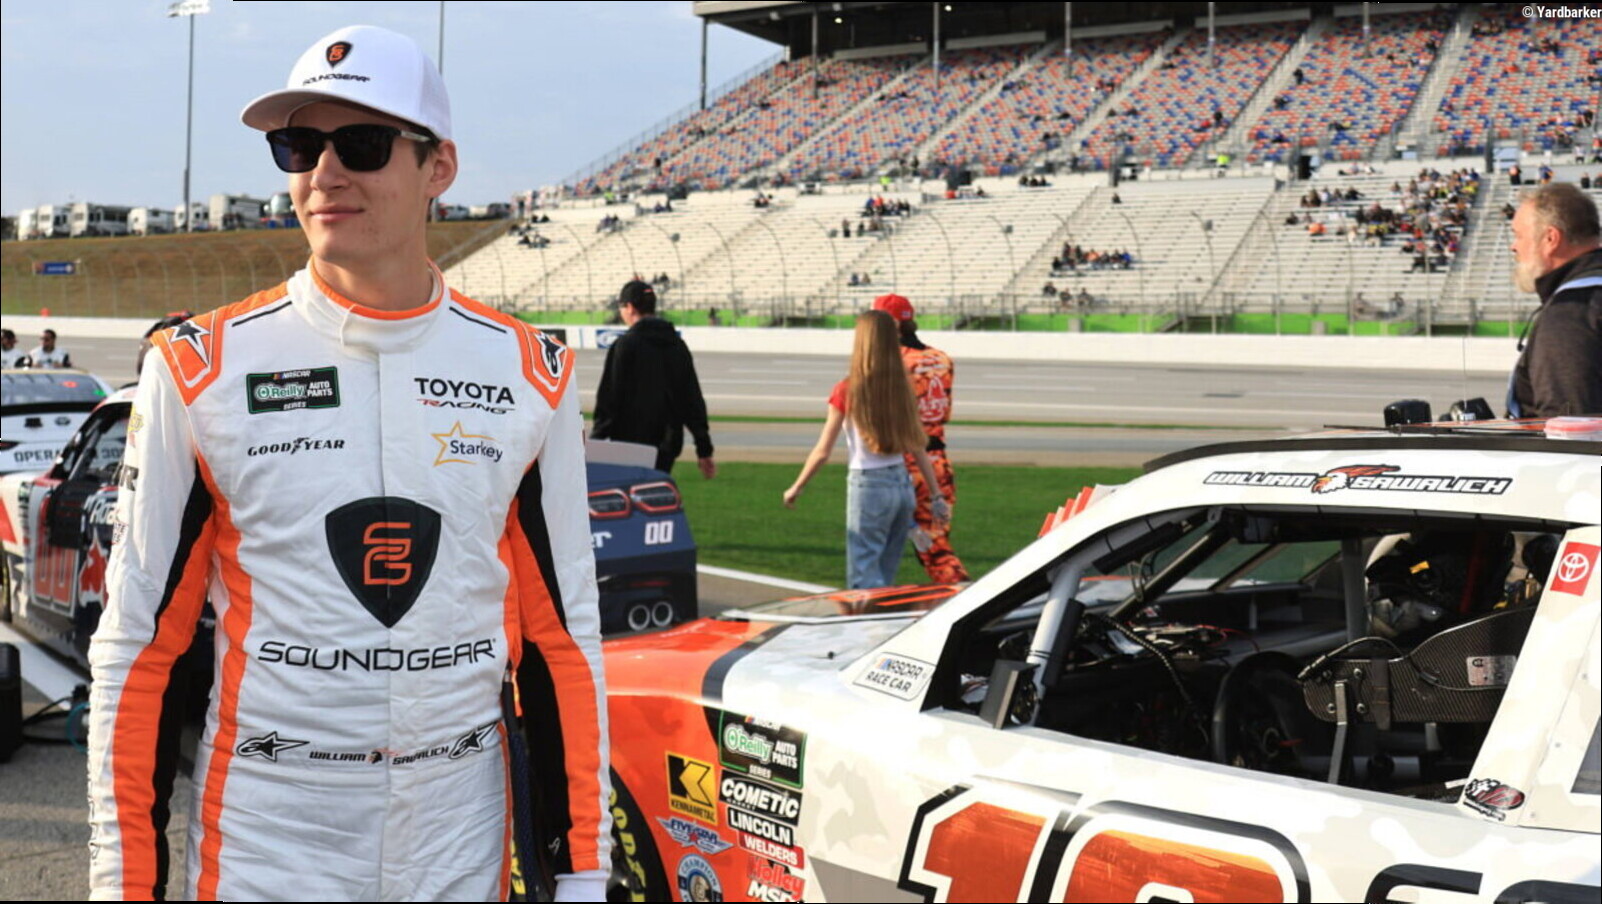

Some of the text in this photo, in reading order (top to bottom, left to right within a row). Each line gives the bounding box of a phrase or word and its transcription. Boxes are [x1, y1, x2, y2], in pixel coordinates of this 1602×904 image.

[256, 383, 306, 401] O'Reilly
[307, 388, 333, 397] PARTS
[309, 381, 330, 390] AUTO
[414, 377, 515, 405] TOYOTA
[416, 398, 516, 415] RACING
[247, 437, 345, 457] GOODYEAR
[450, 440, 503, 463] Starkey
[1203, 471, 1513, 495] WILLIAM SAWALICH
[645, 520, 674, 545] 00
[258, 639, 495, 671] SOUNDGEAR
[866, 671, 912, 692] RACE CAR
[723, 724, 774, 765] O'Reilly
[775, 740, 797, 757] AUTO
[309, 751, 366, 762] WILLIAM
[772, 751, 799, 770] PARTS
[749, 764, 772, 779] SERIES
[721, 778, 800, 818] COMETIC
[729, 809, 791, 846] LINCOLN
[743, 833, 799, 868] WELDERS
